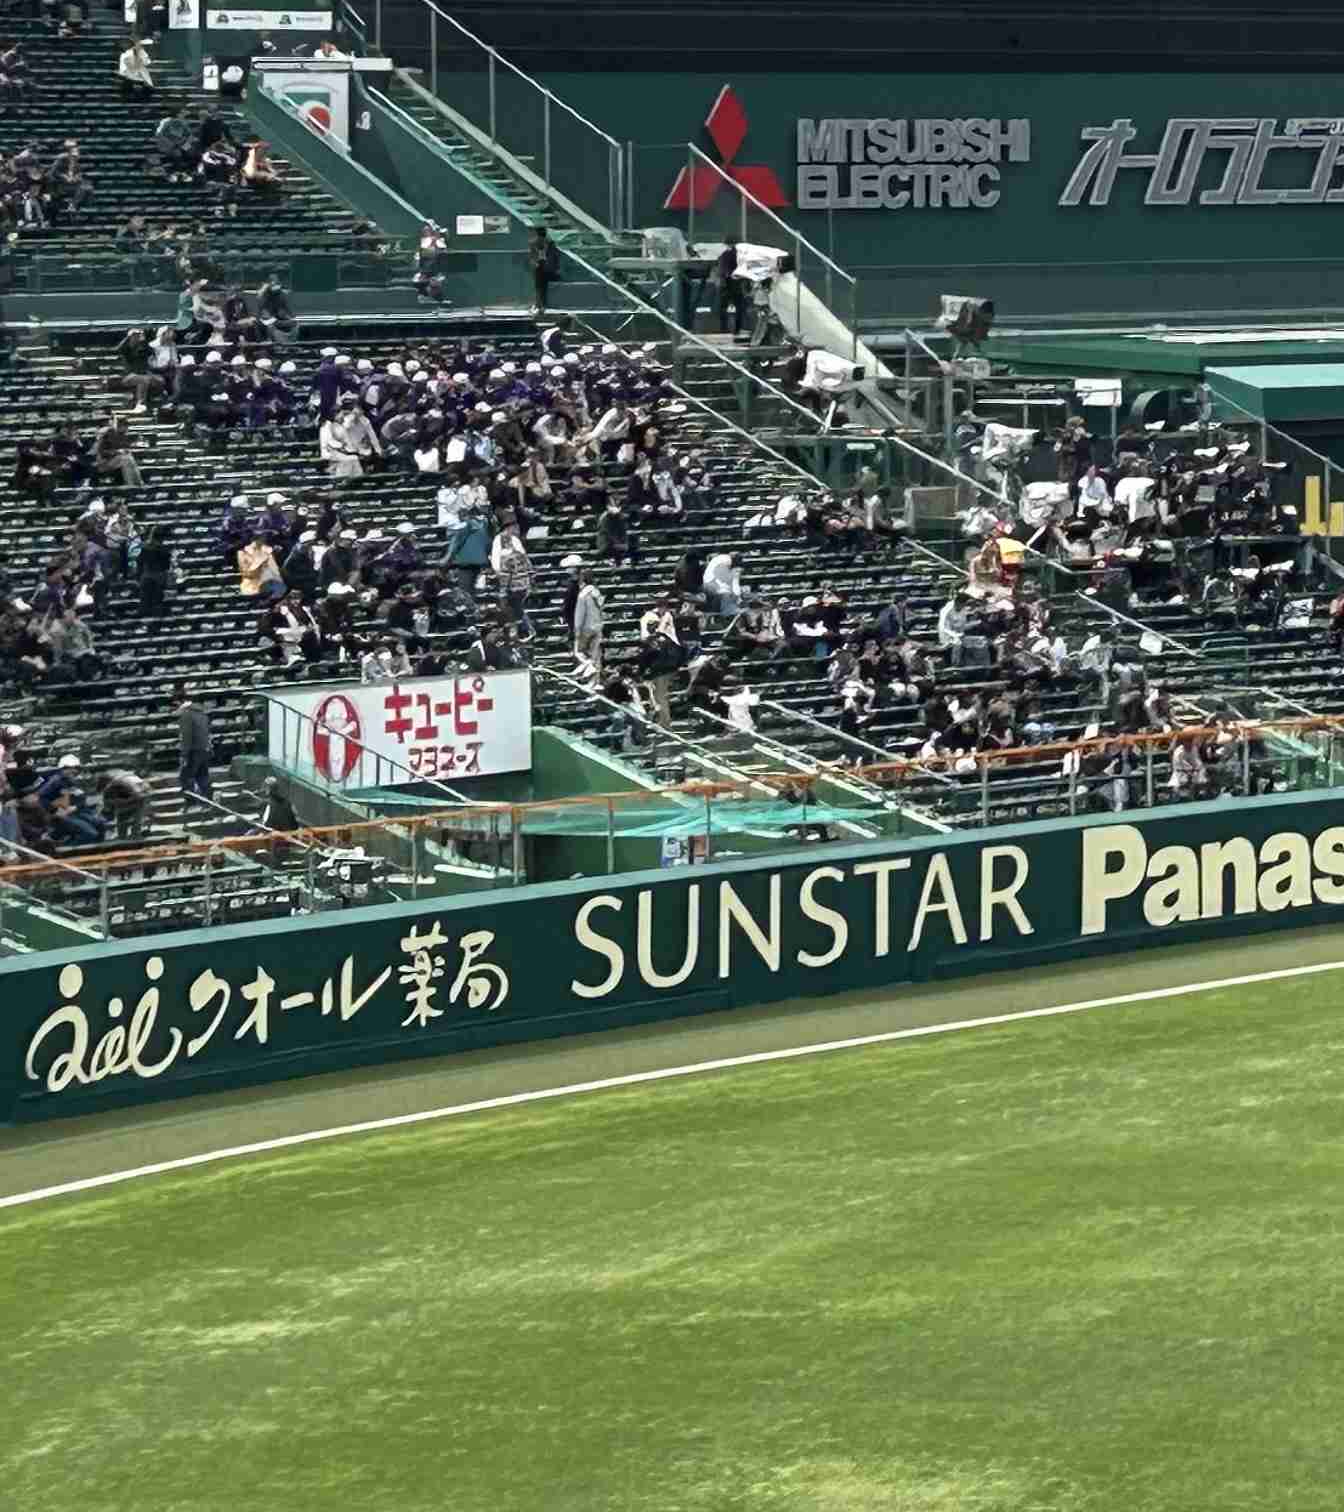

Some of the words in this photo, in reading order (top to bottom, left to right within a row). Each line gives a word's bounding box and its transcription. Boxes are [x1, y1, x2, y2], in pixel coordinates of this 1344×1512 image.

[798, 118, 1031, 164] MITSUBISHI
[797, 164, 1001, 209] ELECTRIC
[384, 676, 494, 744] キューピー
[570, 844, 1035, 999] SUNSTAR
[186, 920, 511, 1057] クオール薬局
